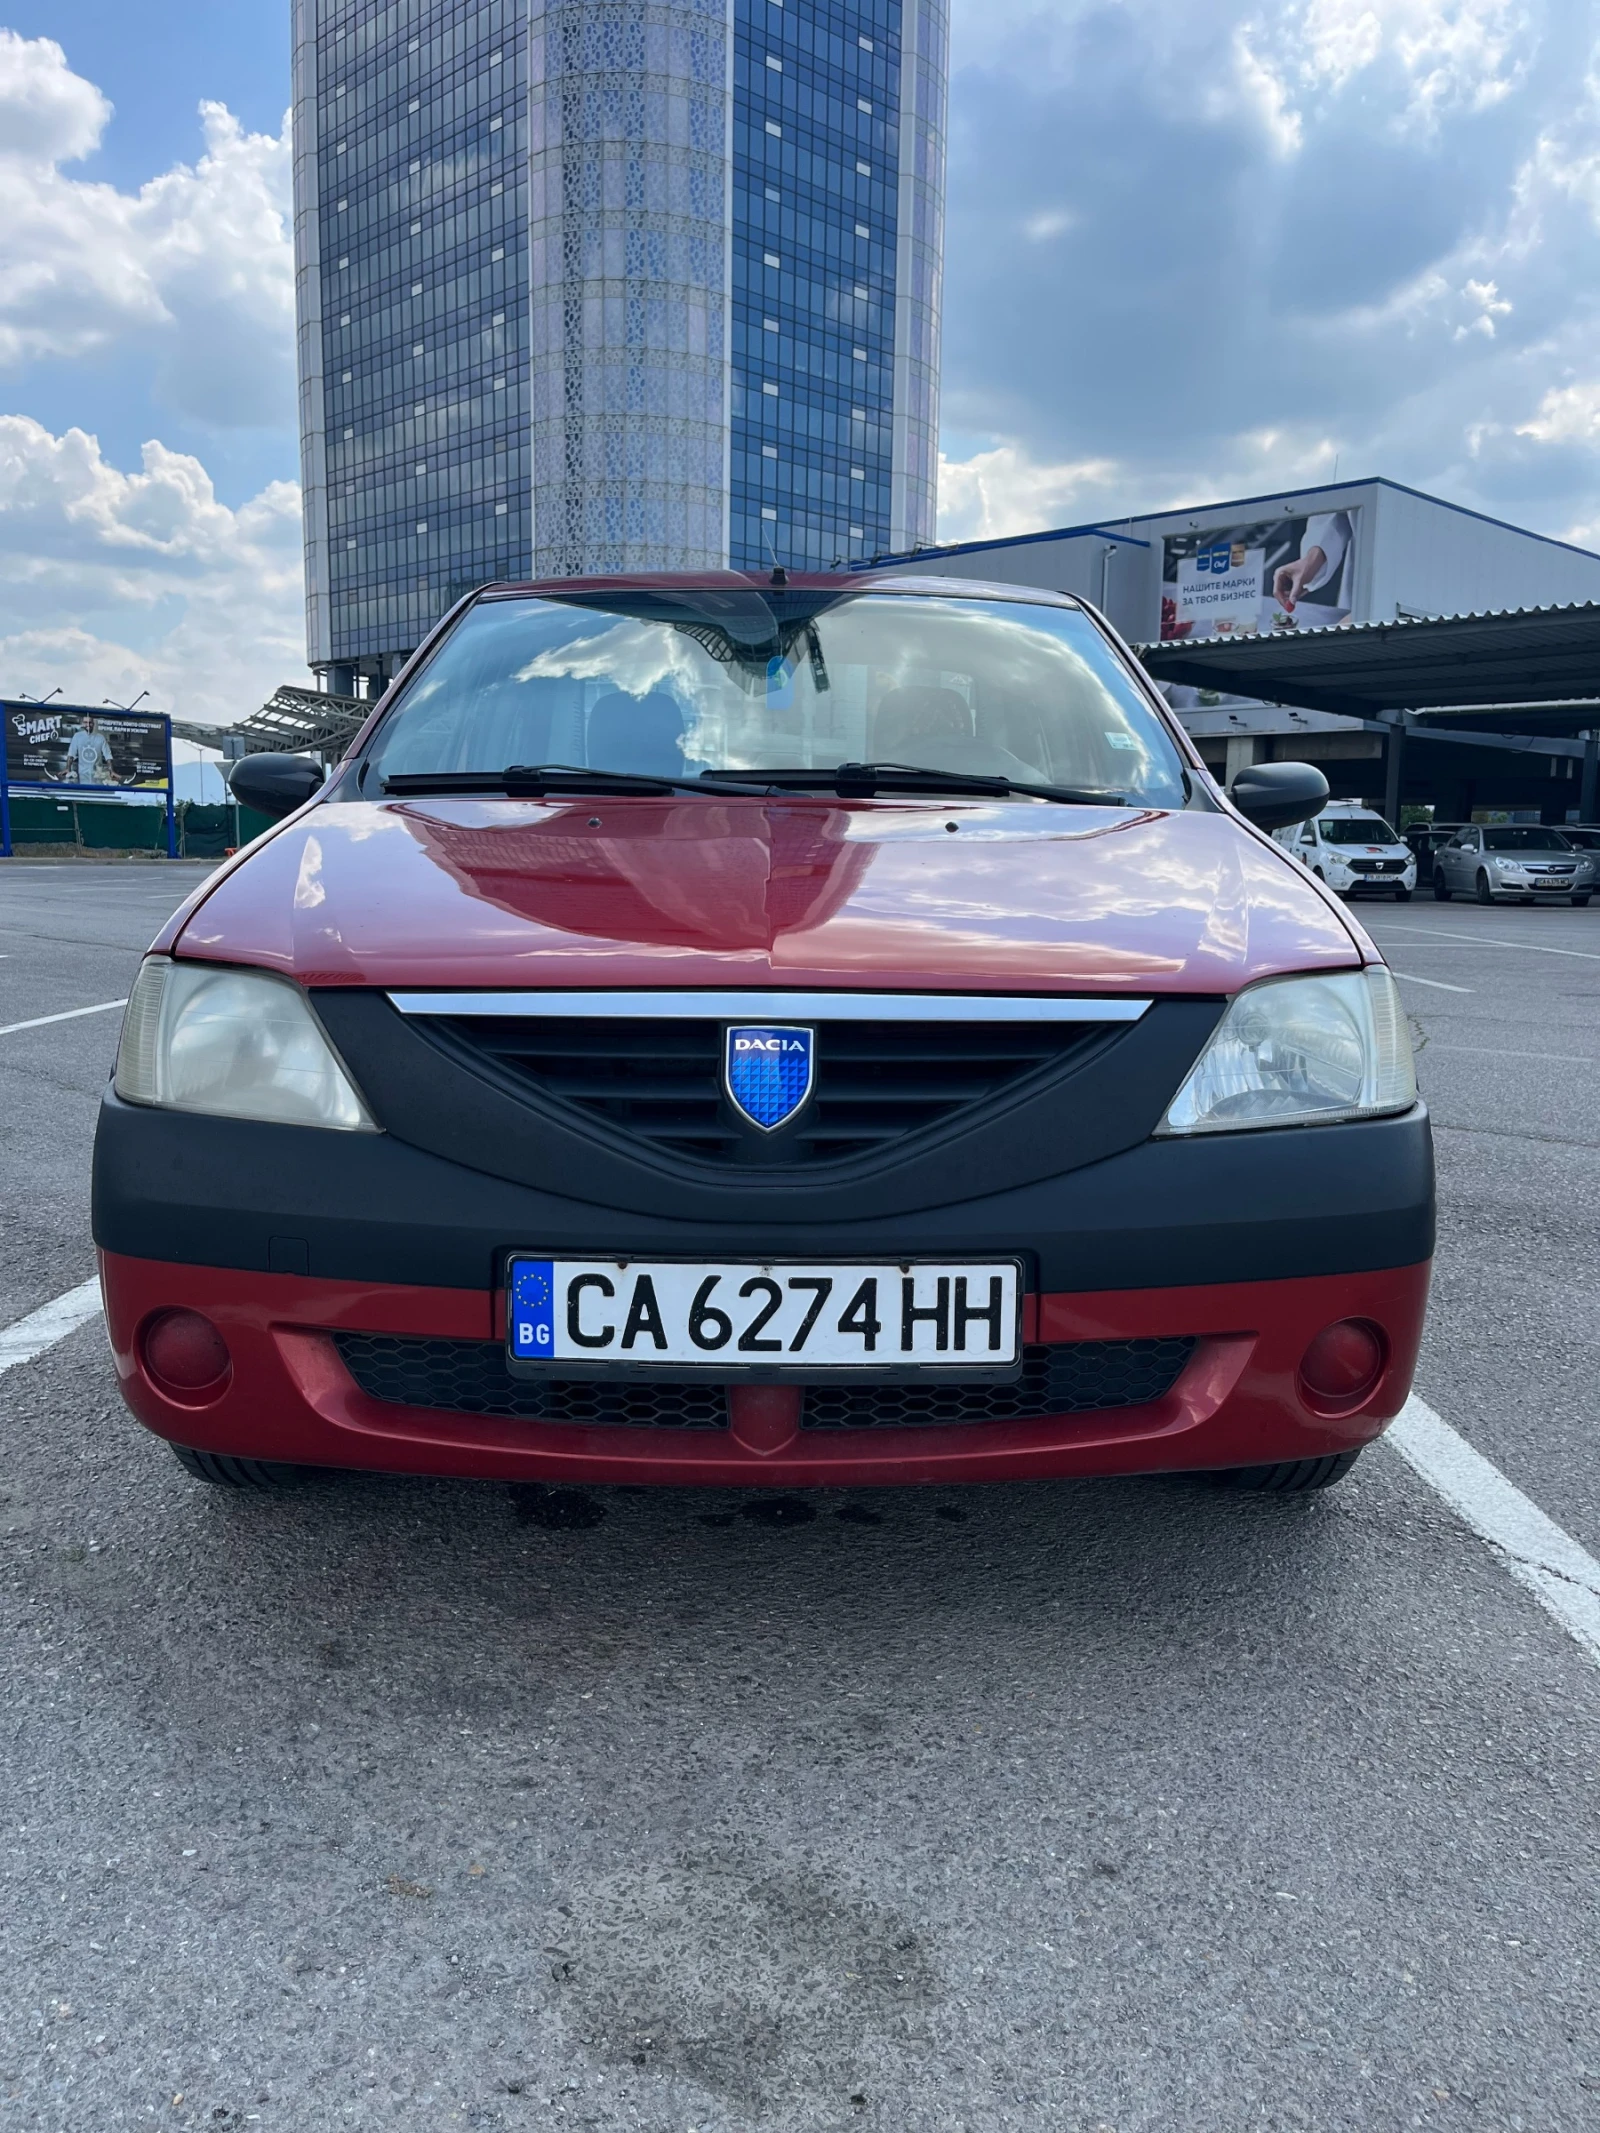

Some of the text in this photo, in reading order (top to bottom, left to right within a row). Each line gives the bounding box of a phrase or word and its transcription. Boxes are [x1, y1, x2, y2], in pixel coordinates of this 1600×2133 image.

[1183, 577, 1255, 594] НАШИТЕ МАРКИ
[1182, 590, 1256, 606] ЗА ТВОЯ БИЗНЕС
[17, 715, 63, 736] SMART
[30, 732, 51, 744] CHEF
[734, 1038, 806, 1053] DACIA
[566, 1273, 1003, 1352] CA 6274 HH
[518, 1322, 551, 1345] BG
